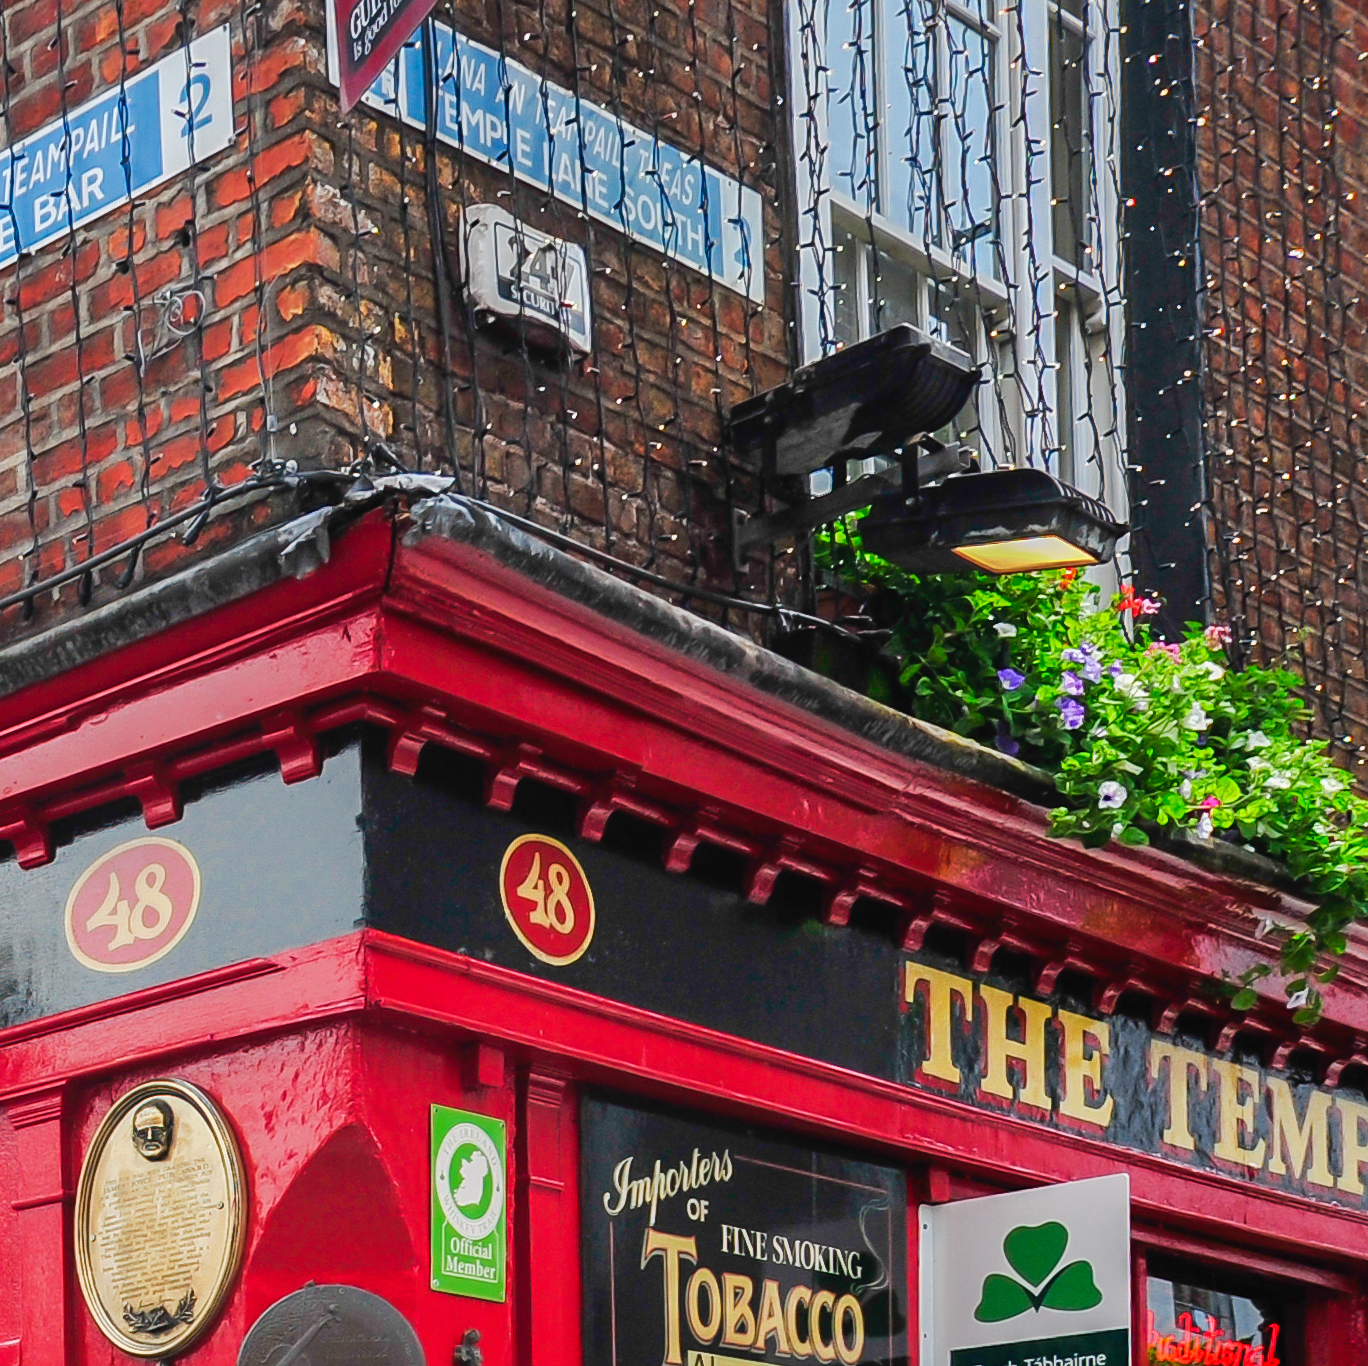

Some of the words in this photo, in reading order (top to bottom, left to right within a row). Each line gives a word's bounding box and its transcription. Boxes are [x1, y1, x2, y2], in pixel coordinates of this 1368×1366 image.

[353, 41, 362, 61] is
[177, 72, 213, 138] 2
[34, 167, 105, 234] BAR
[440, 90, 533, 167] EMPE
[543, 141, 611, 209] LANE
[624, 186, 704, 257] SOUTH
[86, 862, 174, 949] 48
[517, 852, 575, 934] 48
[902, 960, 1114, 1130] THE
[442, 1134, 458, 1157] THE
[459, 1127, 500, 1167] IRELAND
[442, 1194, 475, 1236] WHISKEY
[478, 1210, 498, 1235] TRAIL
[603, 1147, 733, 1228] Importers
[686, 1198, 710, 1223] OF
[445, 1255, 496, 1280] Member
[450, 1236, 493, 1260] Official
[720, 1223, 768, 1261] FINE
[772, 1234, 863, 1279] SMOKING
